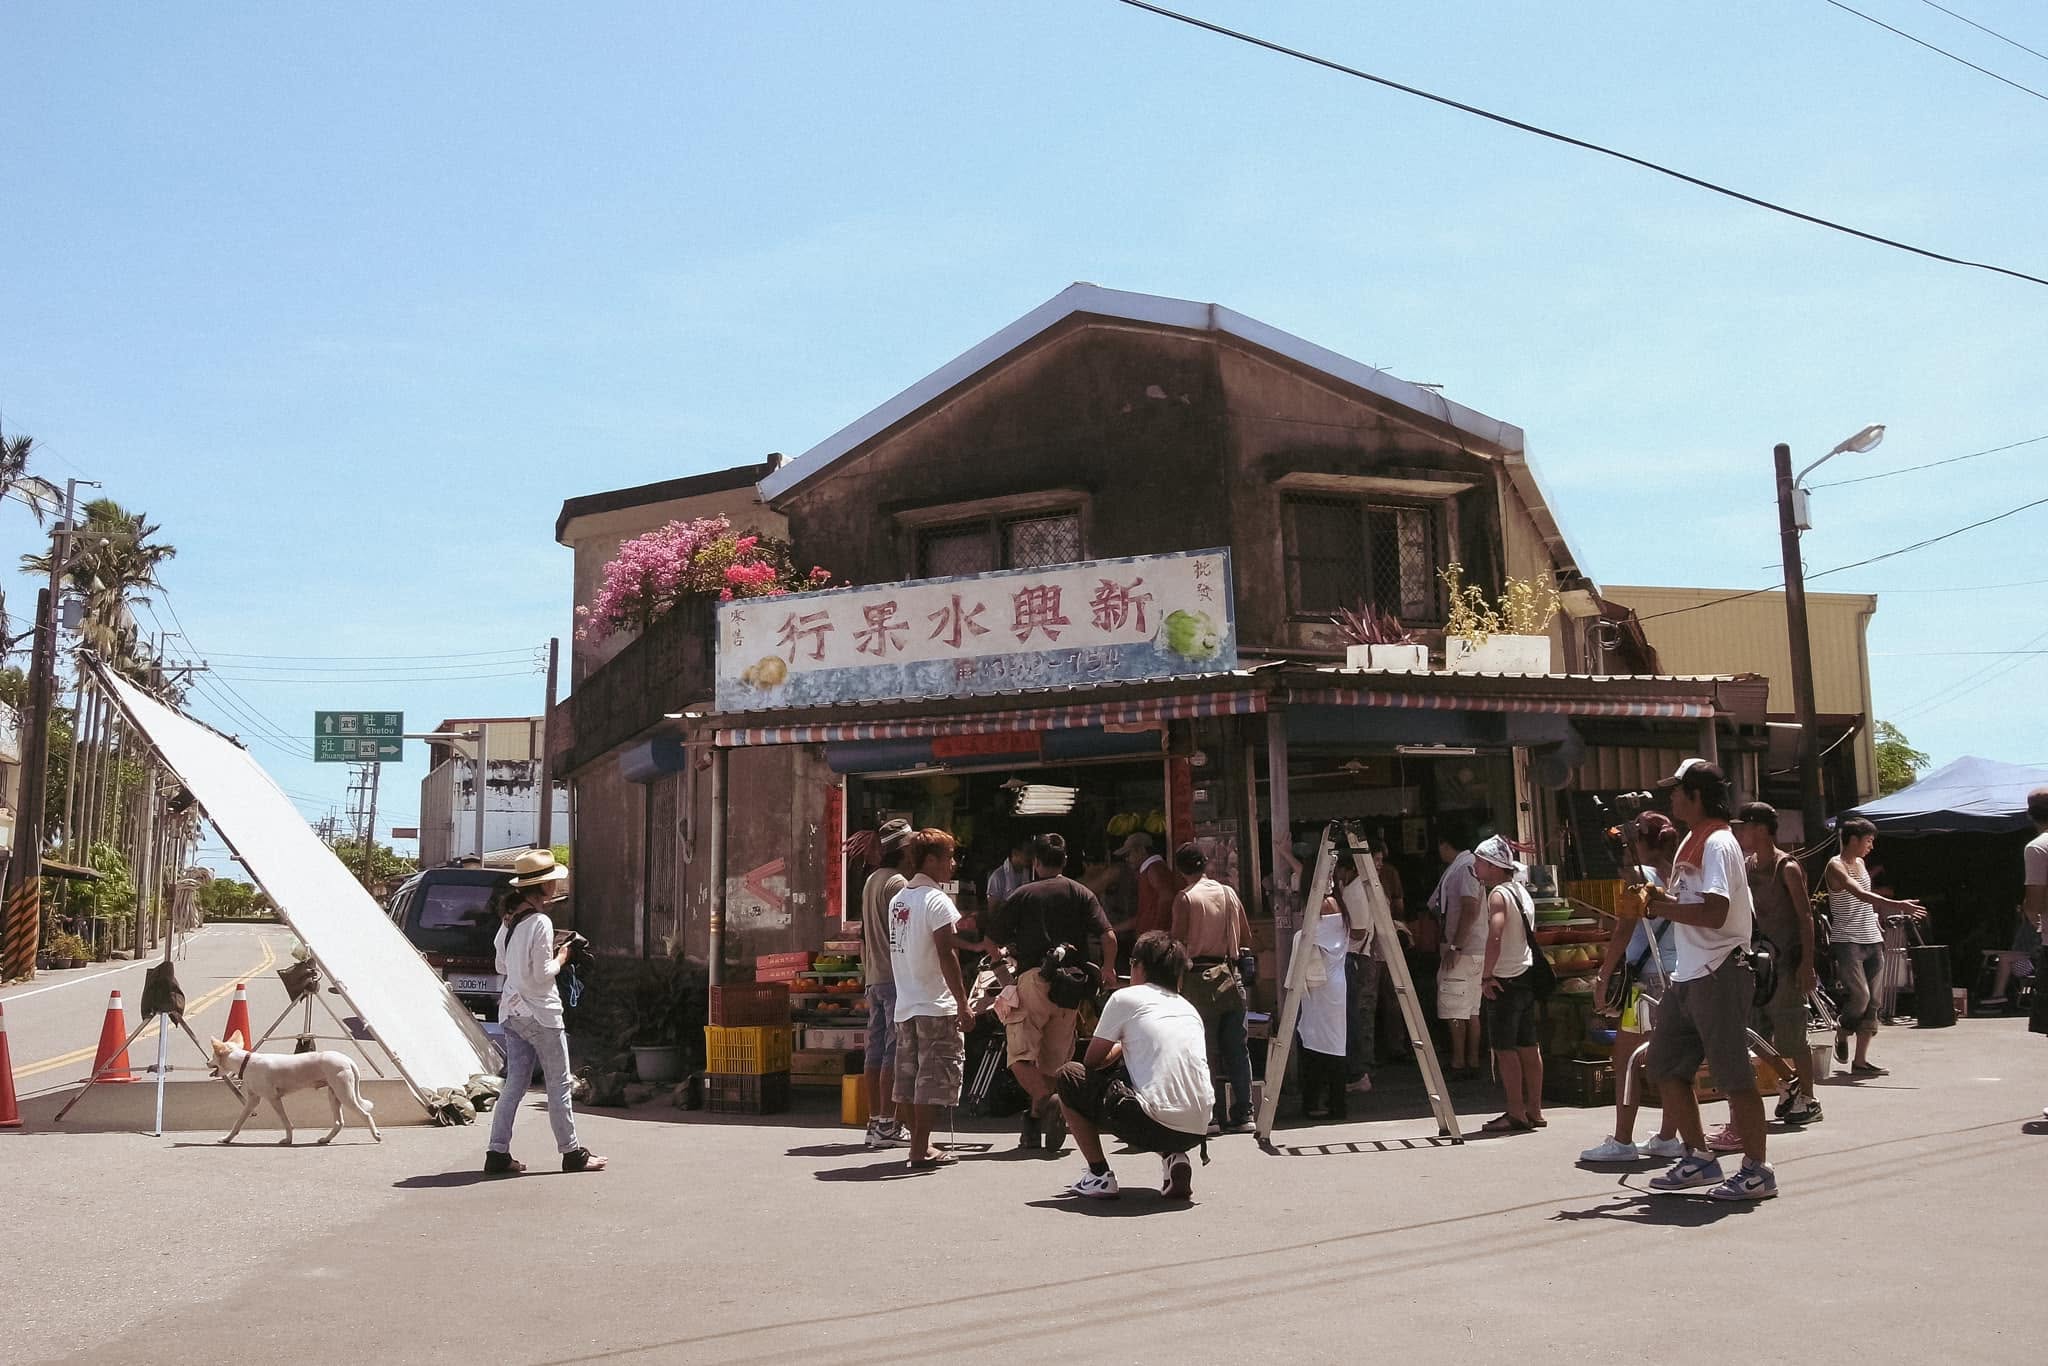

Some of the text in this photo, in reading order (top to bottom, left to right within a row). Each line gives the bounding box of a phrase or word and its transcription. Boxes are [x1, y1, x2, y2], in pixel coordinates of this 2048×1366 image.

[1193, 559, 1214, 602] 批發
[776, 577, 1151, 664] 新興水果行
[362, 714, 398, 726] 社頭
